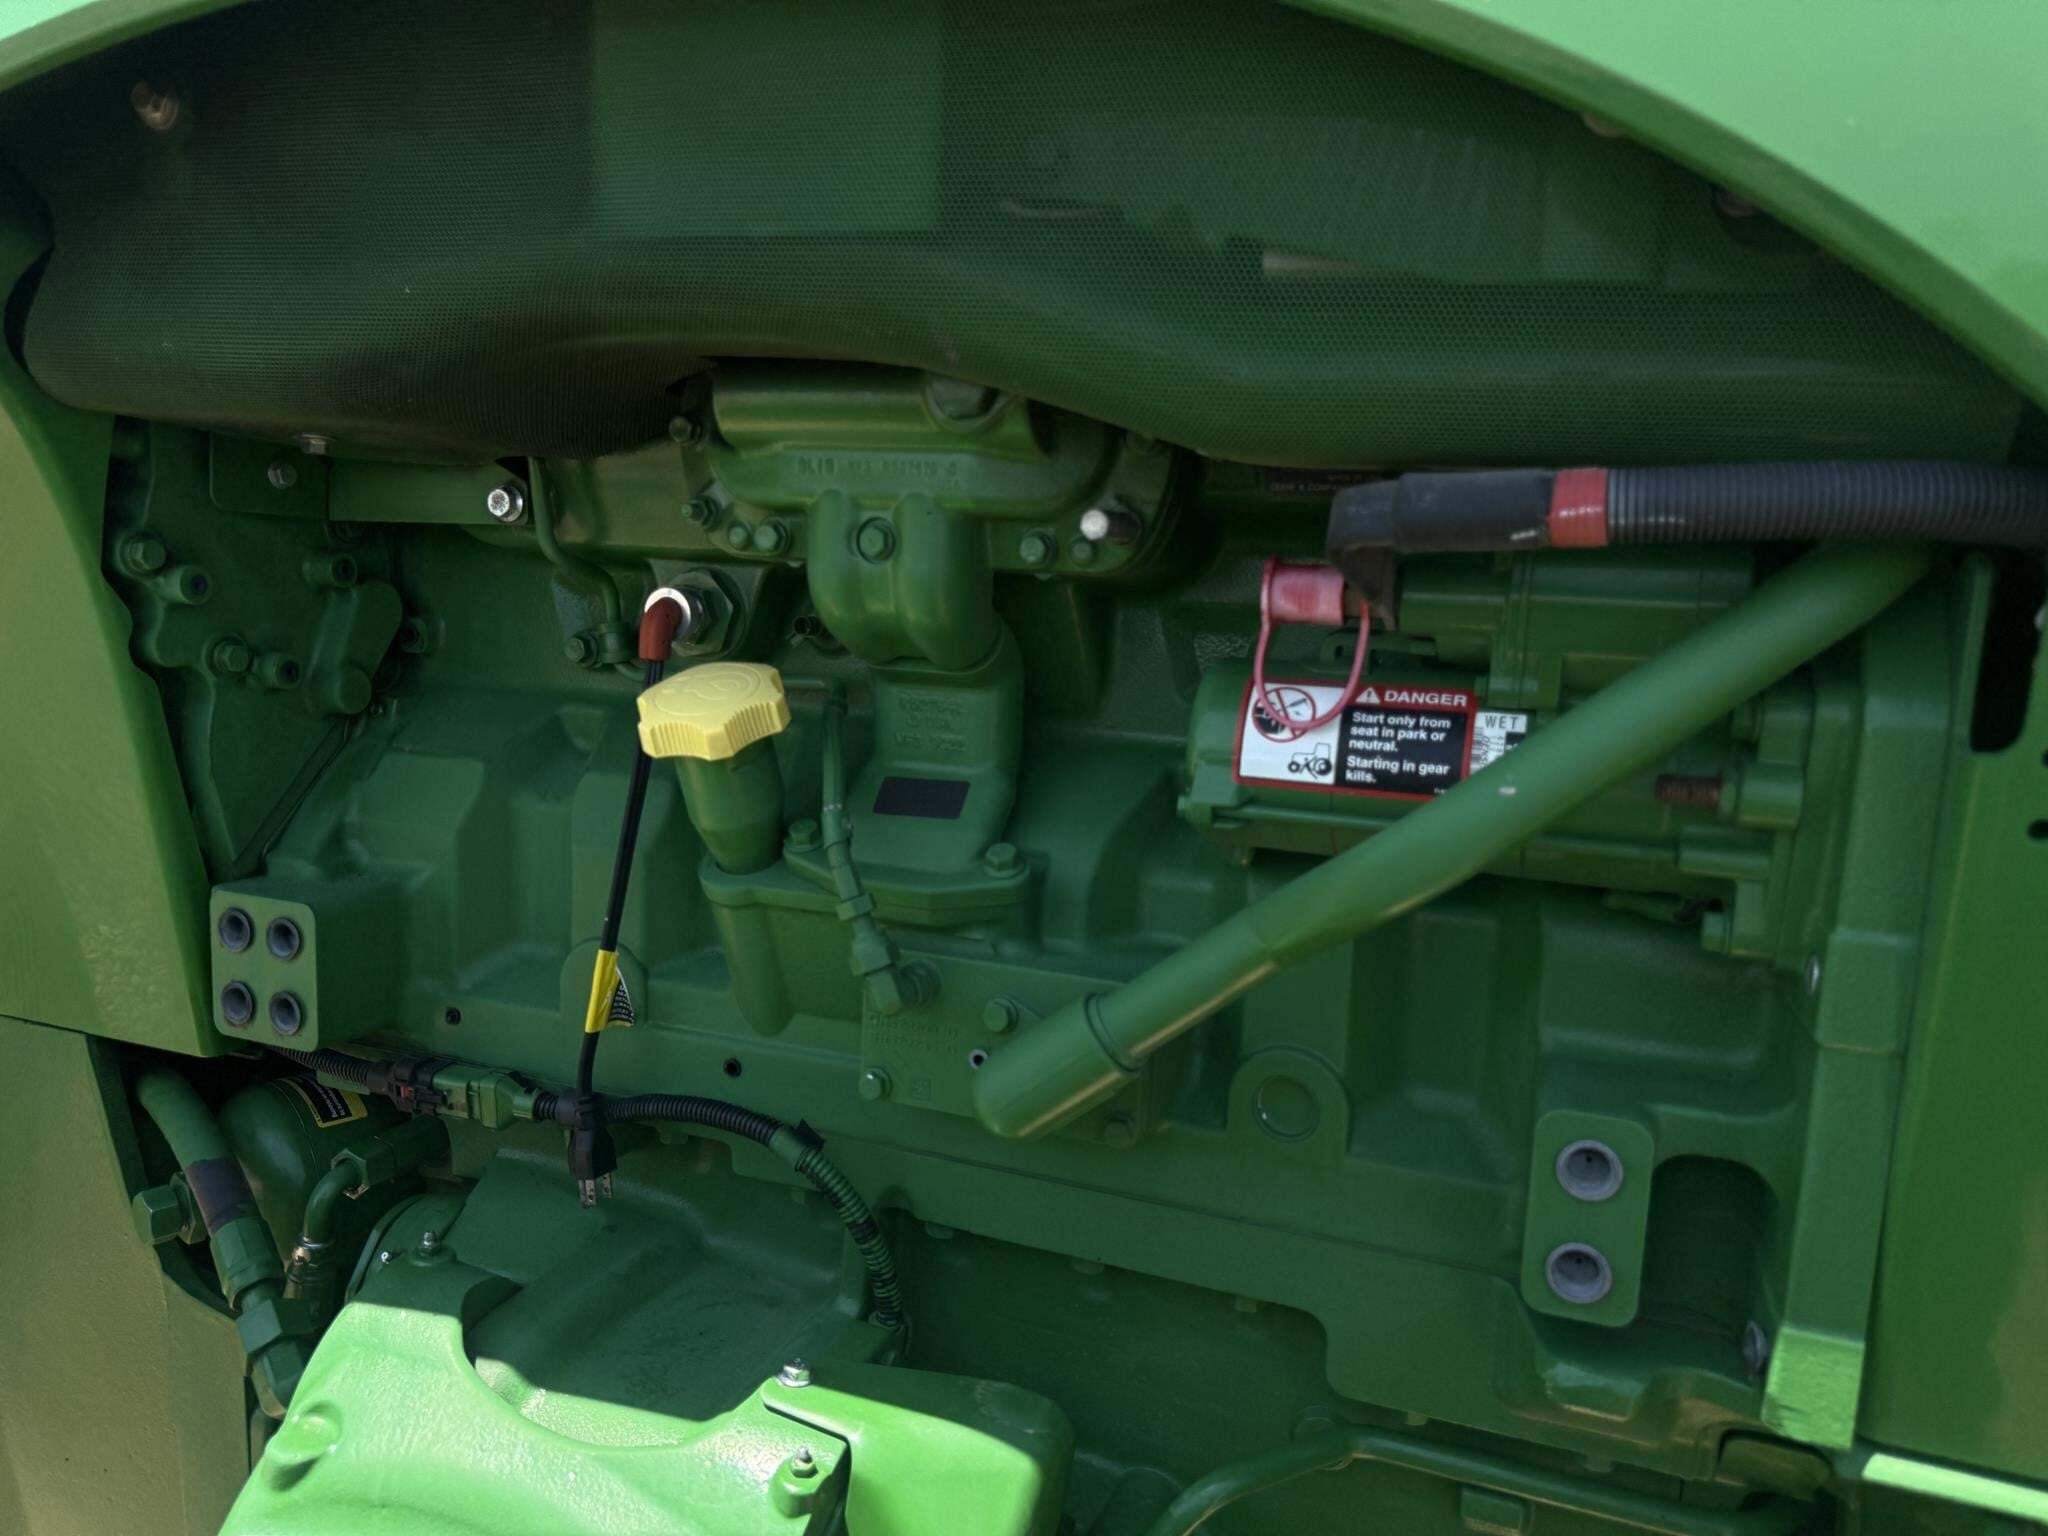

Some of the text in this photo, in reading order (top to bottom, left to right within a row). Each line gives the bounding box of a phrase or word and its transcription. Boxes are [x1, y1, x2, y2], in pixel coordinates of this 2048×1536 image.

[1383, 690, 1468, 707] DANGER
[1352, 711, 1451, 729] Start only from
[1485, 715, 1519, 729] WET
[1350, 726, 1447, 741] seat in park or
[1348, 740, 1398, 752] neutral.
[1347, 755, 1450, 776] Starting in gear
[1345, 769, 1377, 783] kills.
